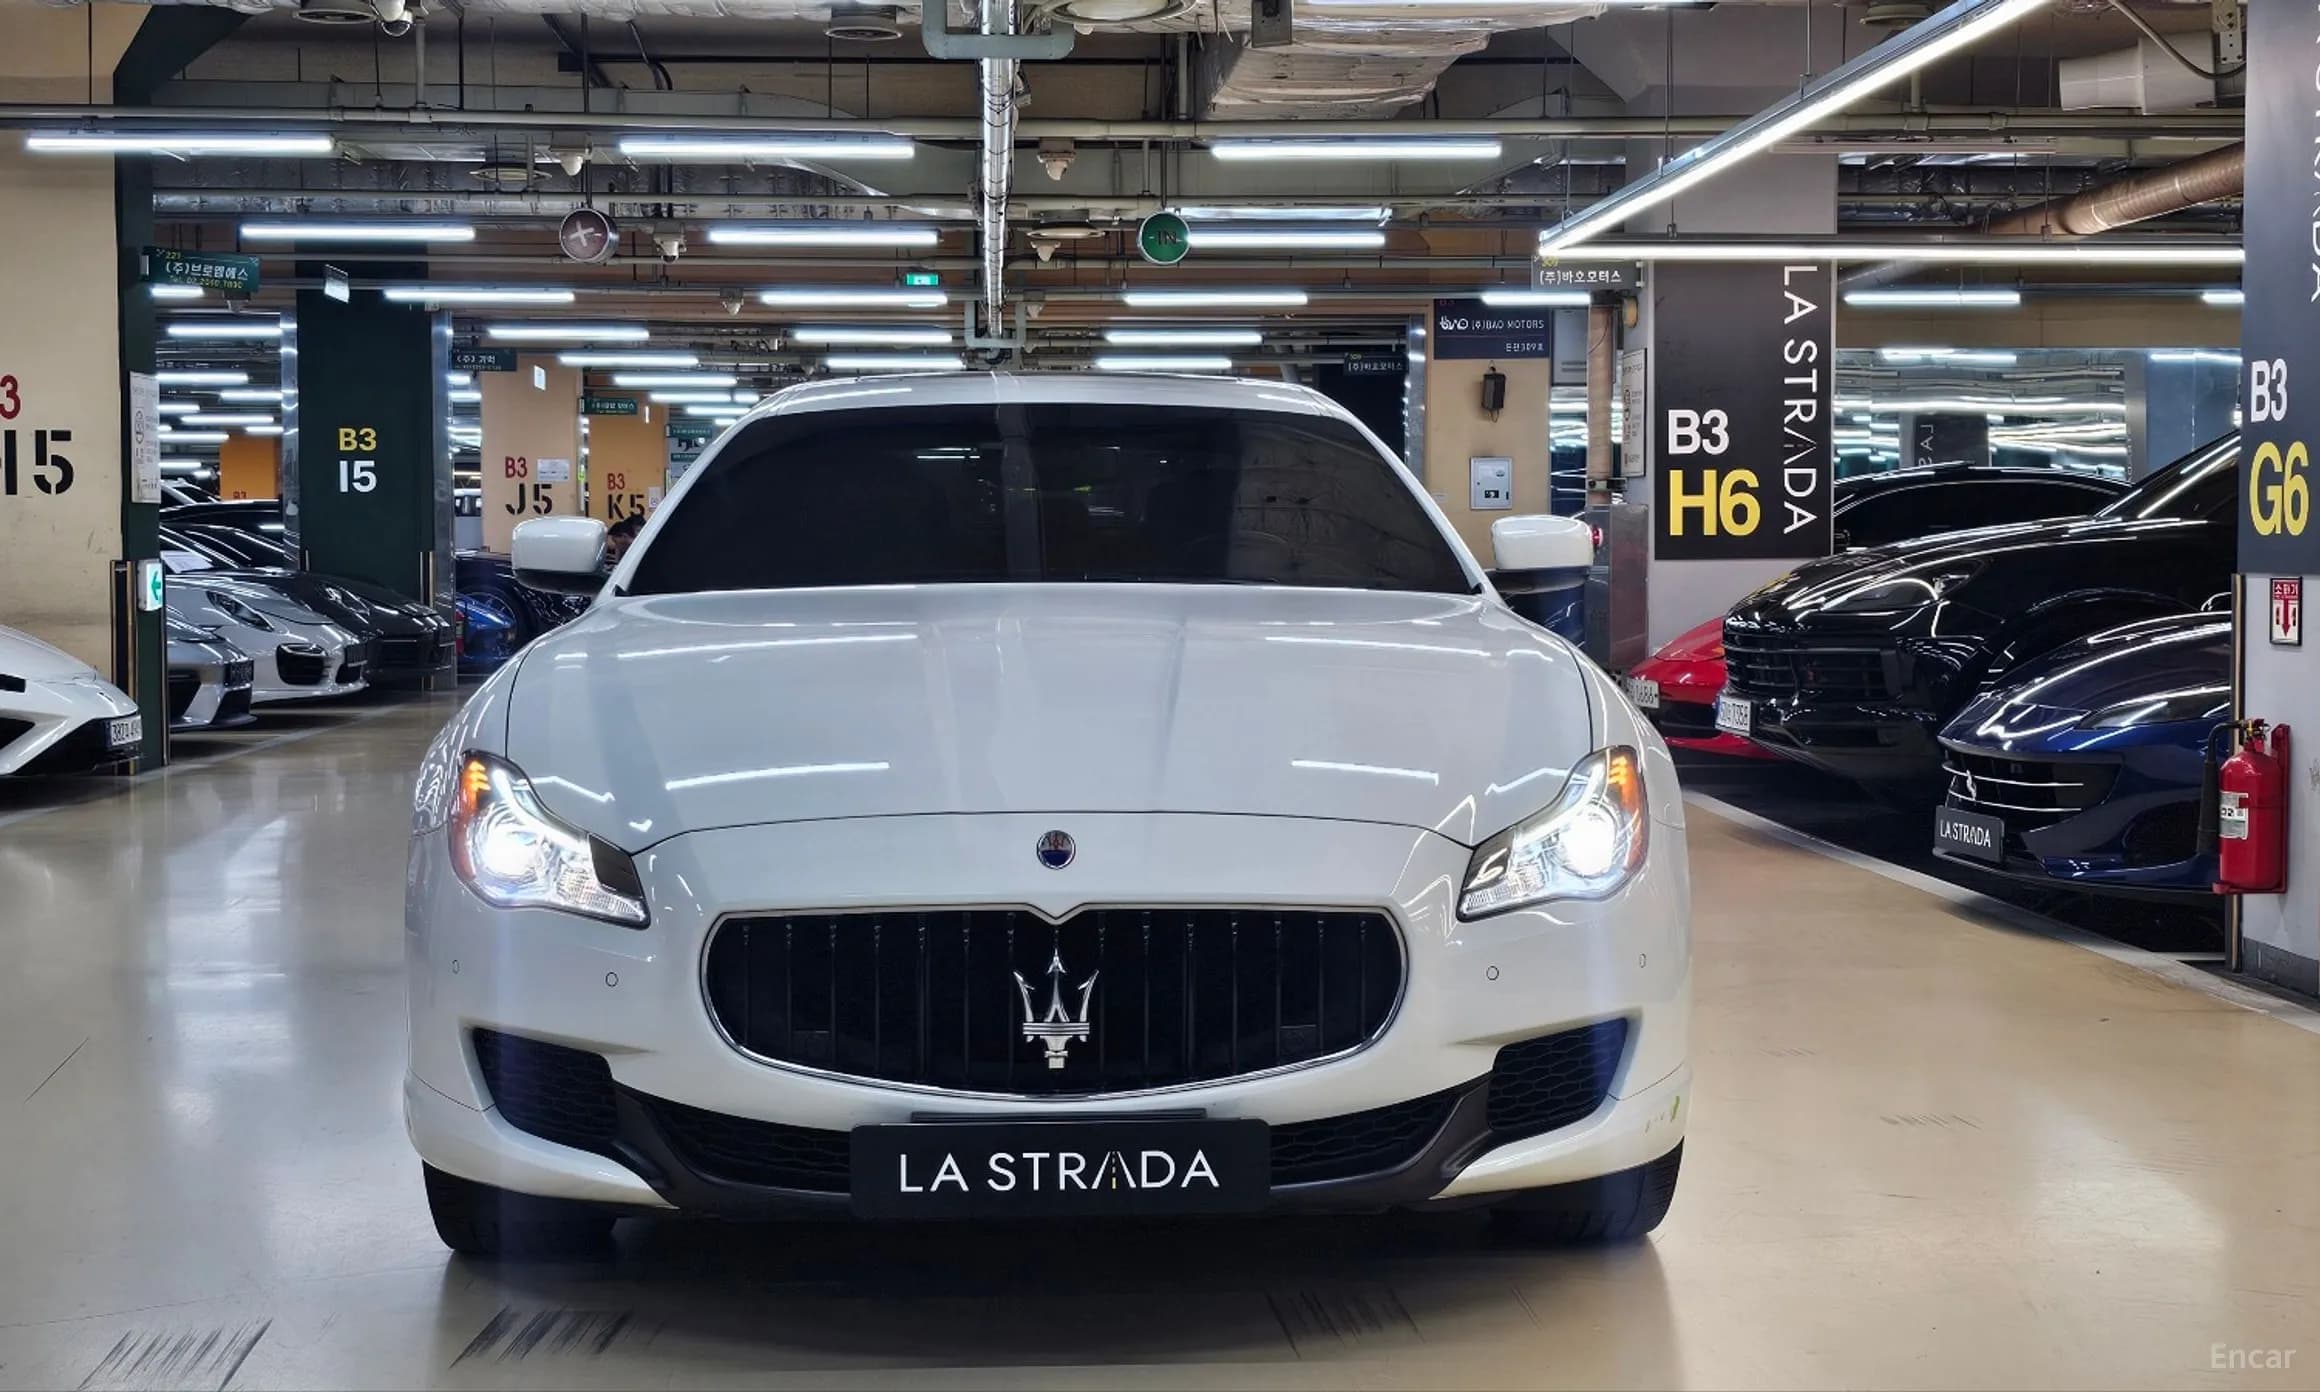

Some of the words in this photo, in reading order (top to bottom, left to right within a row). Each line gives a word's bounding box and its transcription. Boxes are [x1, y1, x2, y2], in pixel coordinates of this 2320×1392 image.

[1158, 230, 1177, 246] IN
[1539, 270, 1622, 286] (주)바오모터스
[1783, 265, 1818, 324] LA
[1507, 319, 1545, 329] MOTORS
[2251, 358, 2288, 422] B3
[339, 427, 377, 451] B3
[1668, 409, 1730, 455] B3
[1783, 339, 1818, 534] STRADA
[505, 456, 528, 479] B3
[607, 473, 625, 490] B3
[505, 483, 553, 515] J5
[1669, 469, 1761, 536] H6
[2249, 441, 2310, 536] G6
[608, 494, 646, 519] K5
[1940, 819, 1952, 839] LA
[1952, 822, 1991, 848] STRADA
[900, 1153, 970, 1193] LA
[987, 1149, 1220, 1191] STRADA
